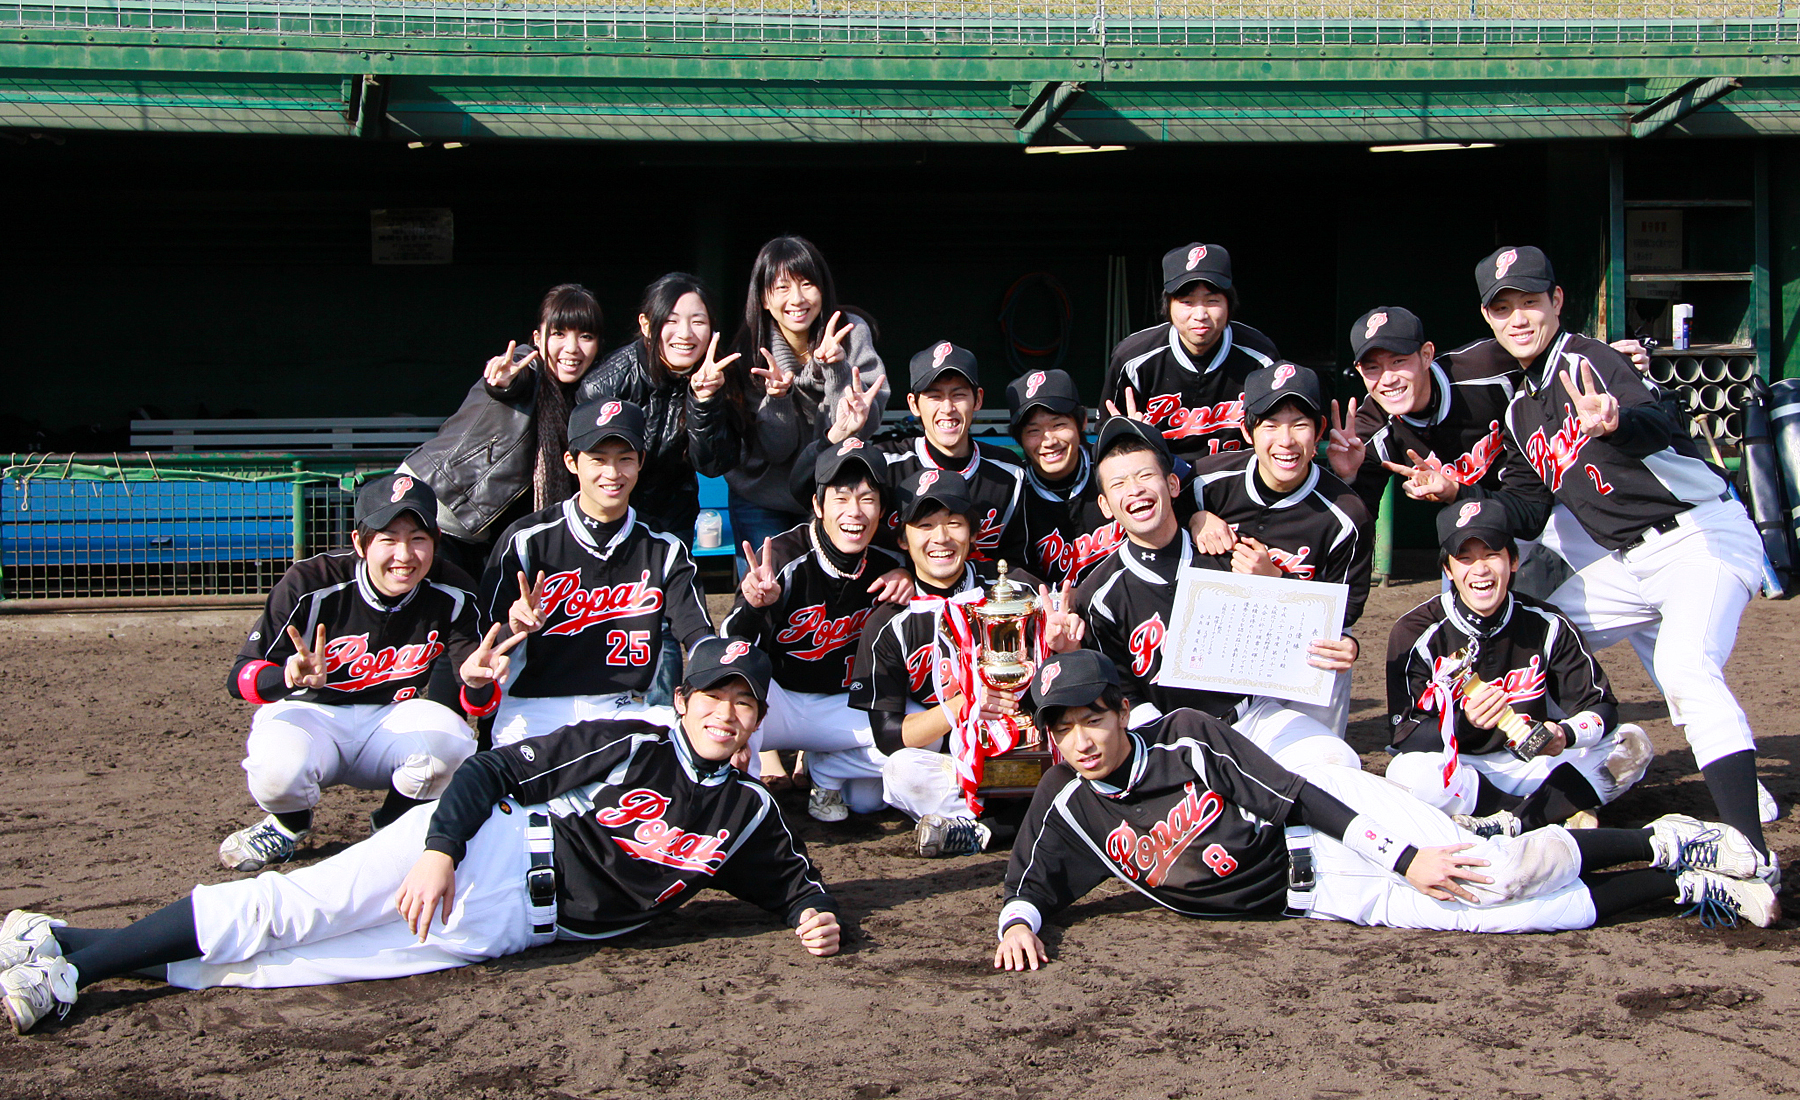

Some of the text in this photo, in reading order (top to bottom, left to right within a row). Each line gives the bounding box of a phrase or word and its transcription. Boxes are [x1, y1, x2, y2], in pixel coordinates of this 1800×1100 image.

[1186, 245, 1207, 271] P
[1495, 249, 1518, 279] P
[1364, 312, 1388, 339] P
[932, 342, 953, 368] P
[1026, 371, 1046, 398] P
[1271, 364, 1296, 390] P
[596, 401, 623, 426] P
[390, 476, 414, 502] P
[916, 470, 940, 496] P
[1584, 463, 1614, 496] 2
[1456, 501, 1481, 527] P
[540, 567, 664, 637] Popai
[324, 630, 445, 693] Popai
[606, 630, 650, 667] 25
[720, 640, 751, 664] P
[1041, 661, 1062, 696] P
[596, 788, 730, 876] Popai
[1106, 781, 1225, 888] Popai
[1365, 829, 1377, 841] 8
[1202, 843, 1239, 878] 8
